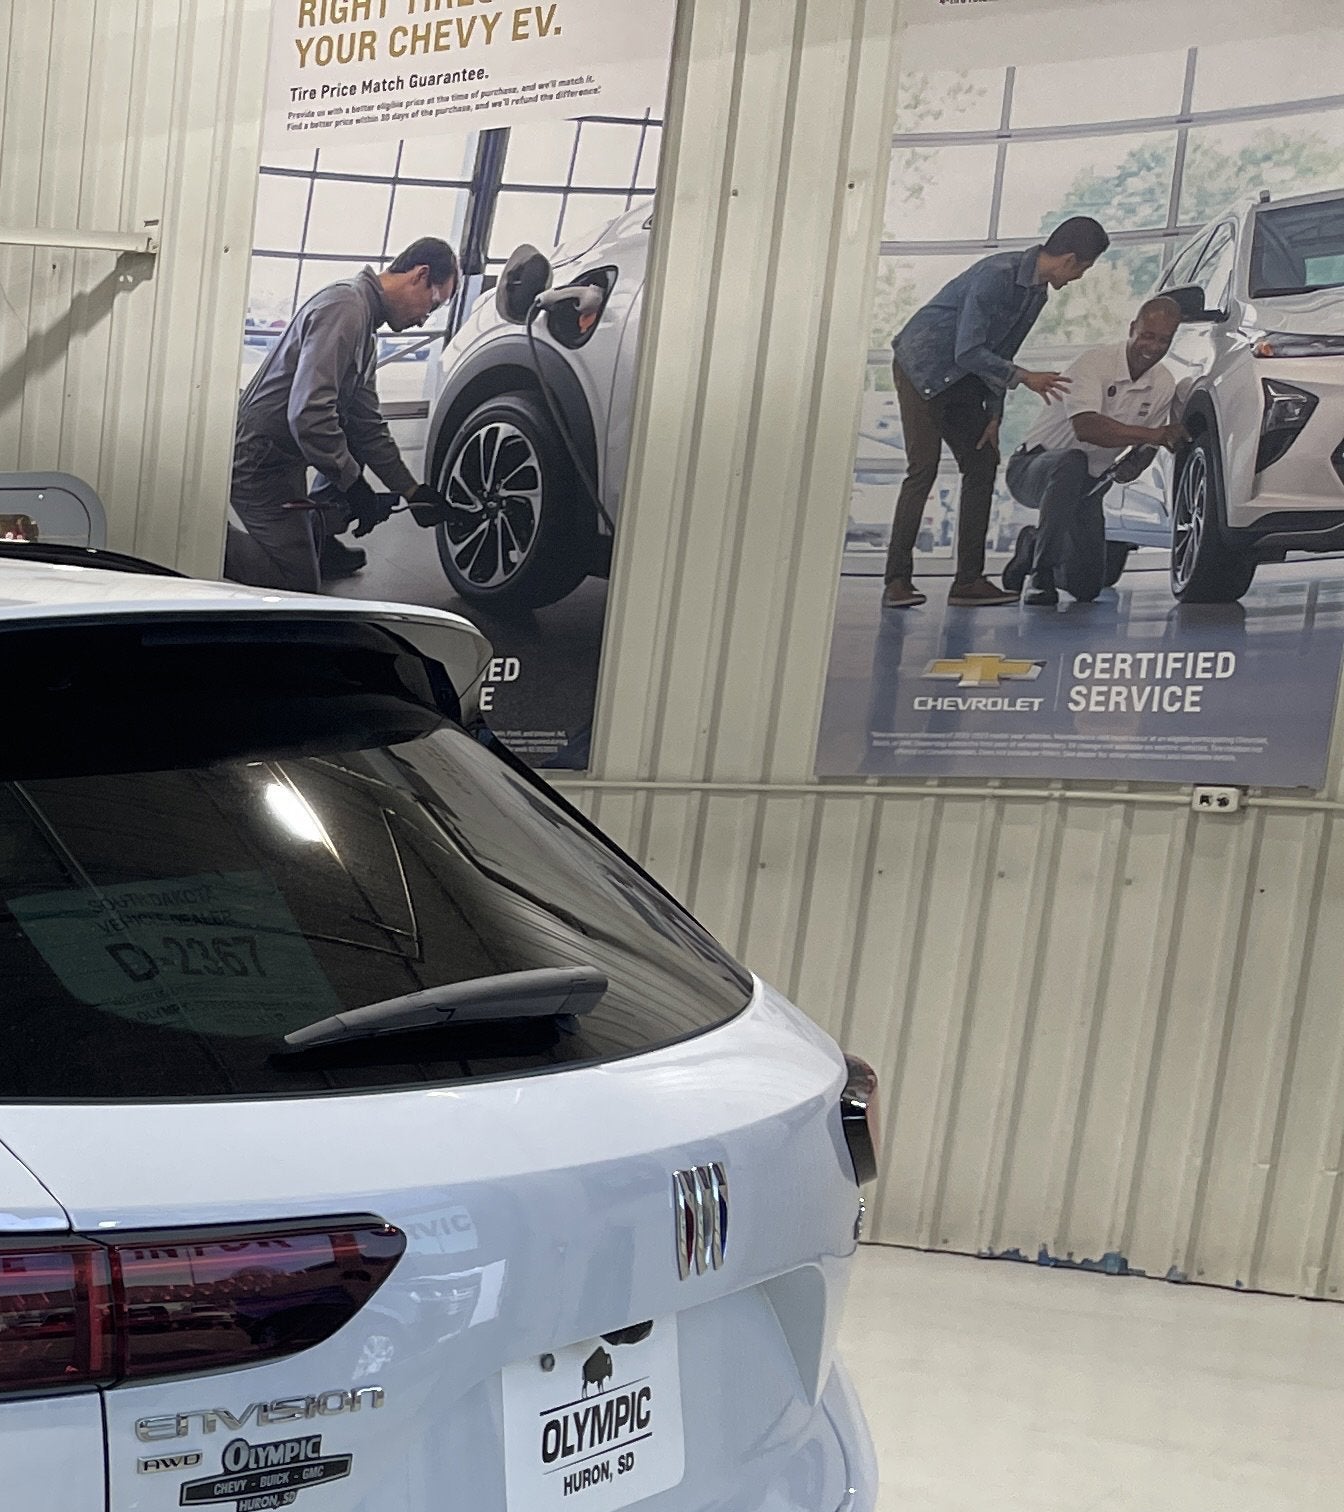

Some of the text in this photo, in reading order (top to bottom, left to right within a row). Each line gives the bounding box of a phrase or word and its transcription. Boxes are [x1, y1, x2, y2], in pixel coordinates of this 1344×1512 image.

[295, 4, 562, 69] YOUR CHEVY EV.
[290, 68, 490, 102] Tire Price Match Guarantee.
[405, 99, 425, 109] price
[437, 94, 449, 103] the
[471, 90, 480, 99] of
[334, 118, 354, 129] price
[392, 111, 410, 121] days
[411, 109, 420, 118] of
[421, 107, 434, 116] the
[511, 94, 538, 106] refund
[540, 92, 554, 101] the
[1072, 651, 1236, 680] CERTIFIED
[913, 696, 1044, 711] CHEVROLET
[1068, 685, 1204, 713] SERVICE
[542, 1386, 652, 1464] OLYMPIC
[143, 1452, 201, 1471] AWD
[224, 1437, 321, 1472] OLYMPIC
[213, 1479, 247, 1496] CHEVY
[259, 1472, 289, 1488] BUICK
[302, 1466, 324, 1480] GMC
[563, 1451, 635, 1496] HURON, SD
[238, 1491, 297, 1512] HURON, SD
